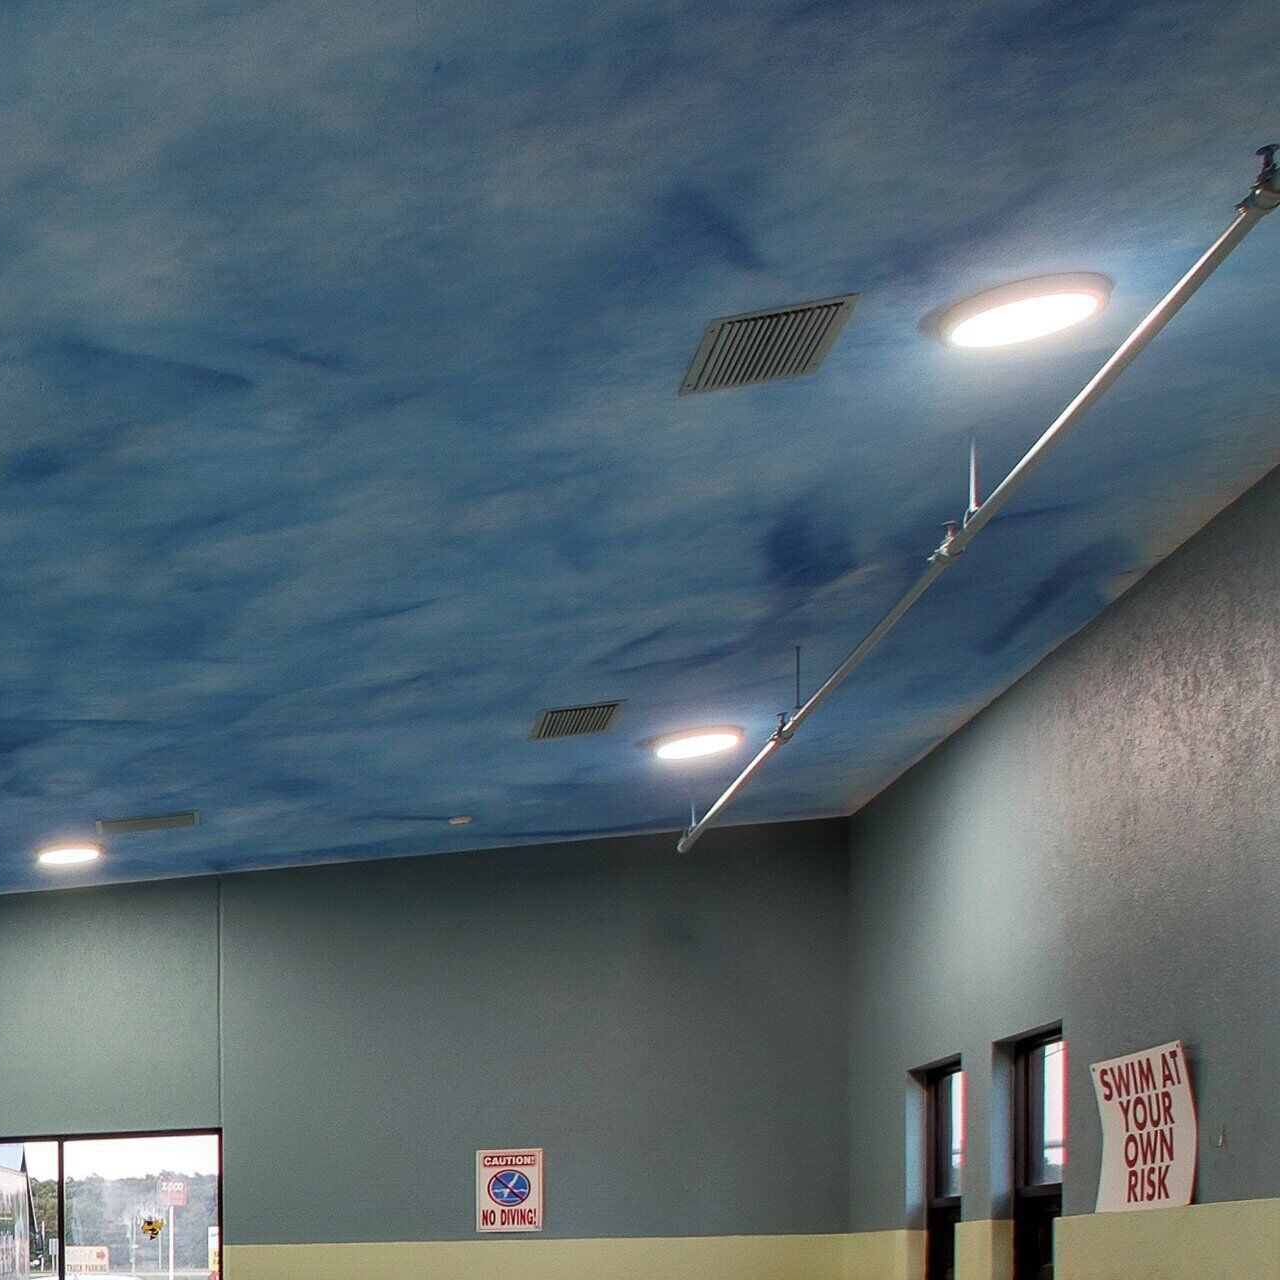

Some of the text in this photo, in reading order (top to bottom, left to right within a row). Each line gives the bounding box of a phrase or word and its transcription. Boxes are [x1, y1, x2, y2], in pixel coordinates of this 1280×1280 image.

[1100, 1050, 1182, 1102] SWIM AT
[1118, 1091, 1175, 1133] YOUR
[484, 1155, 535, 1166] CAUTION!
[1124, 1127, 1174, 1168] OWN
[1127, 1165, 1170, 1203] RISK
[482, 1208, 537, 1226] NO DIVING!
